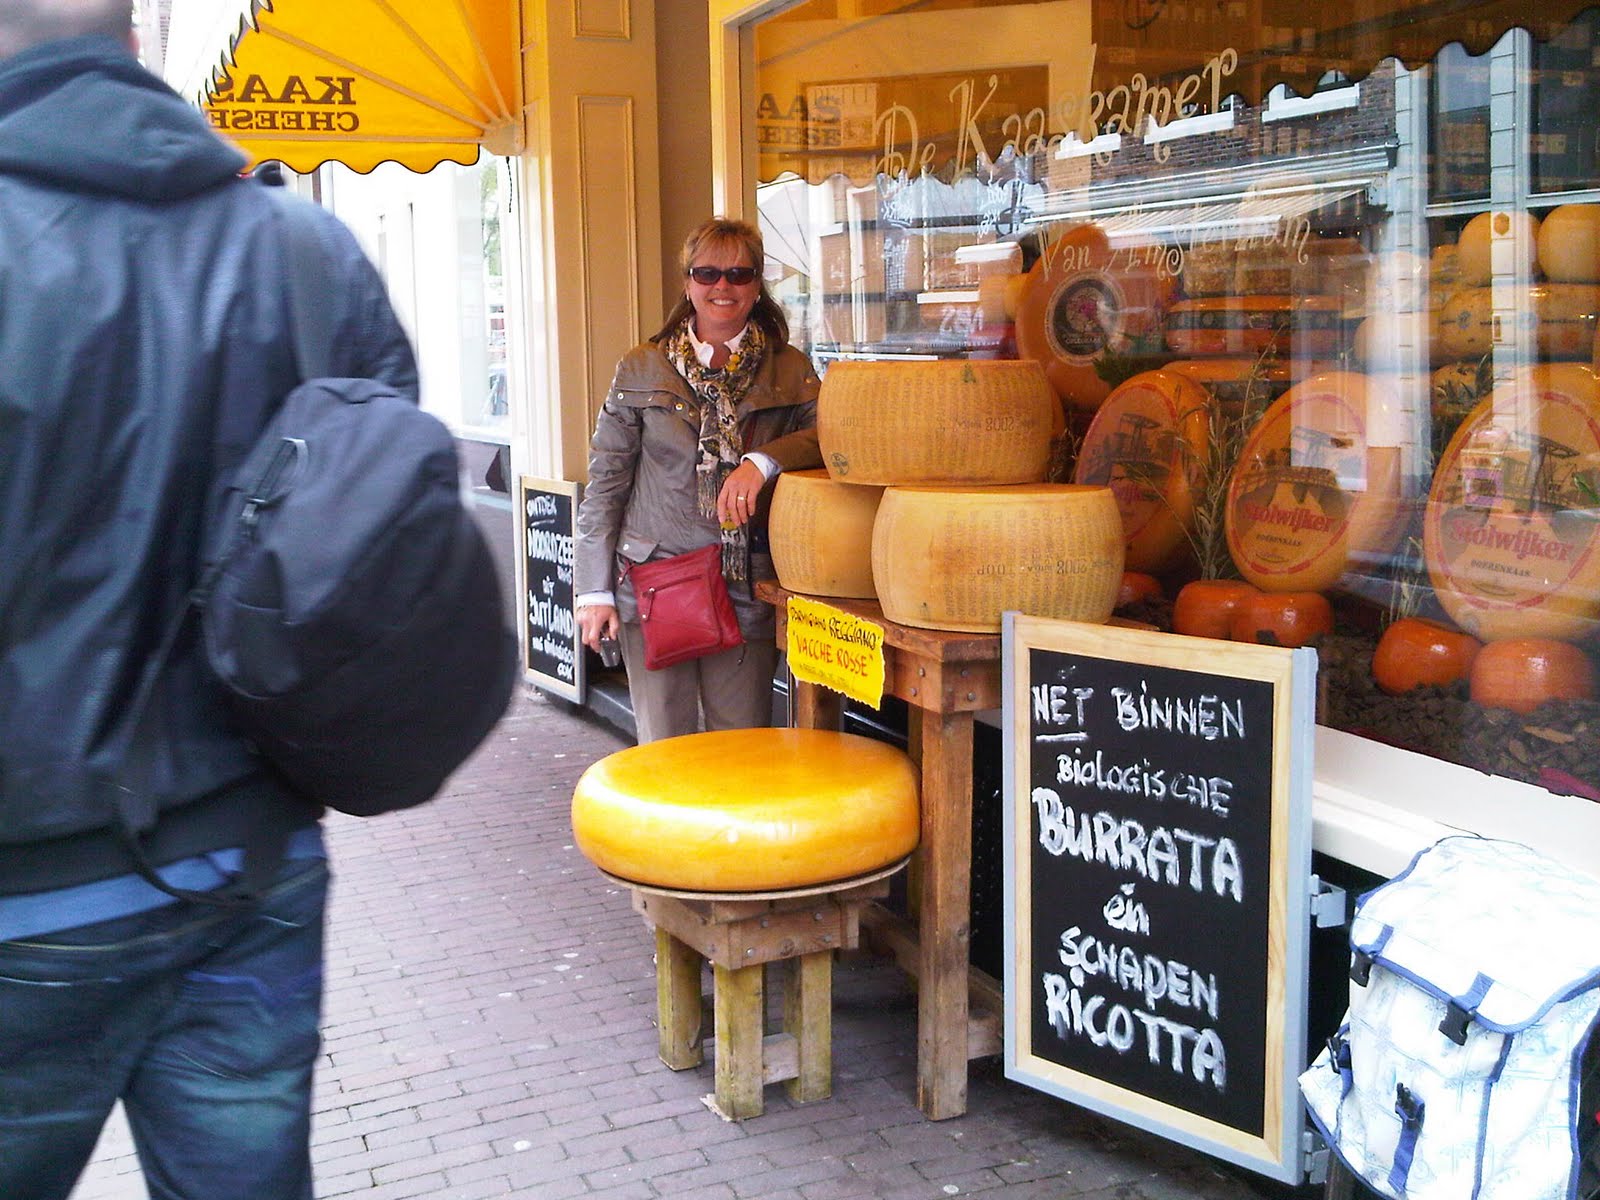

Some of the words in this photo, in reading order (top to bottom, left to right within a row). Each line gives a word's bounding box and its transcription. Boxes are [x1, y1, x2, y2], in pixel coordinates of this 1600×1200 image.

[1032, 684, 1094, 726] NET
[1031, 787, 1243, 902] BURRATA
[1042, 966, 1228, 1092] RICOTTA
